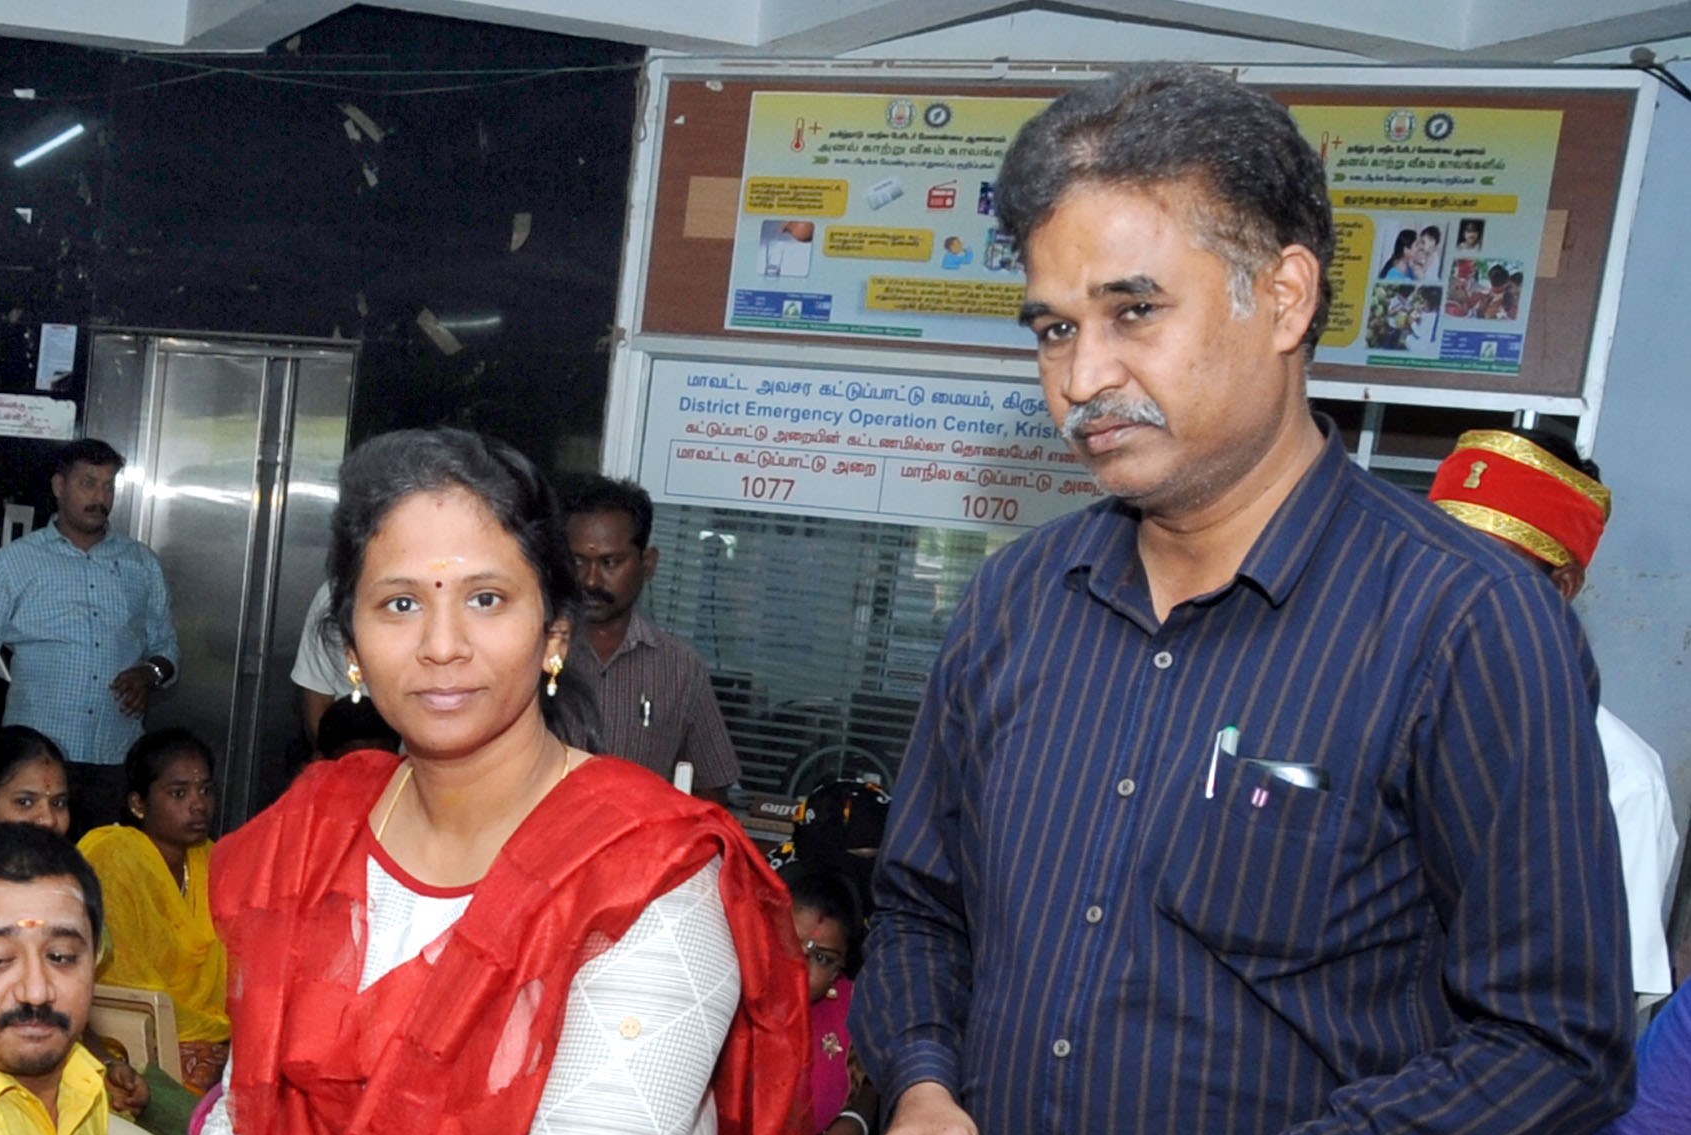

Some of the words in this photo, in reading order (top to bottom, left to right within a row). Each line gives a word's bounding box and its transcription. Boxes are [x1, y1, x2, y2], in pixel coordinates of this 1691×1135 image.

[948, 145, 1005, 158] காலங்க
[686, 372, 748, 391] மாவட்ட
[756, 378, 812, 396] அவசர
[818, 380, 925, 406] கட்டுப்பாட்டு
[679, 397, 740, 416] District
[746, 401, 843, 426] Emergency
[849, 408, 936, 429] Operation
[943, 415, 1008, 437] Center,
[685, 420, 768, 441] கட்டுப்பாட்டு
[773, 428, 841, 444] அறையின்
[847, 432, 945, 452] கட்டணமில்லா
[951, 440, 1043, 462] தொலைபேசி
[676, 446, 732, 463] மாவட்ட
[733, 449, 827, 474] கட்டுப்பாட்டு
[832, 459, 878, 477] அறை
[900, 461, 952, 483] மாநில
[953, 467, 1053, 492] கட்டுப்பாட்டு
[741, 476, 796, 501] 1077
[962, 494, 1019, 521] 1070
